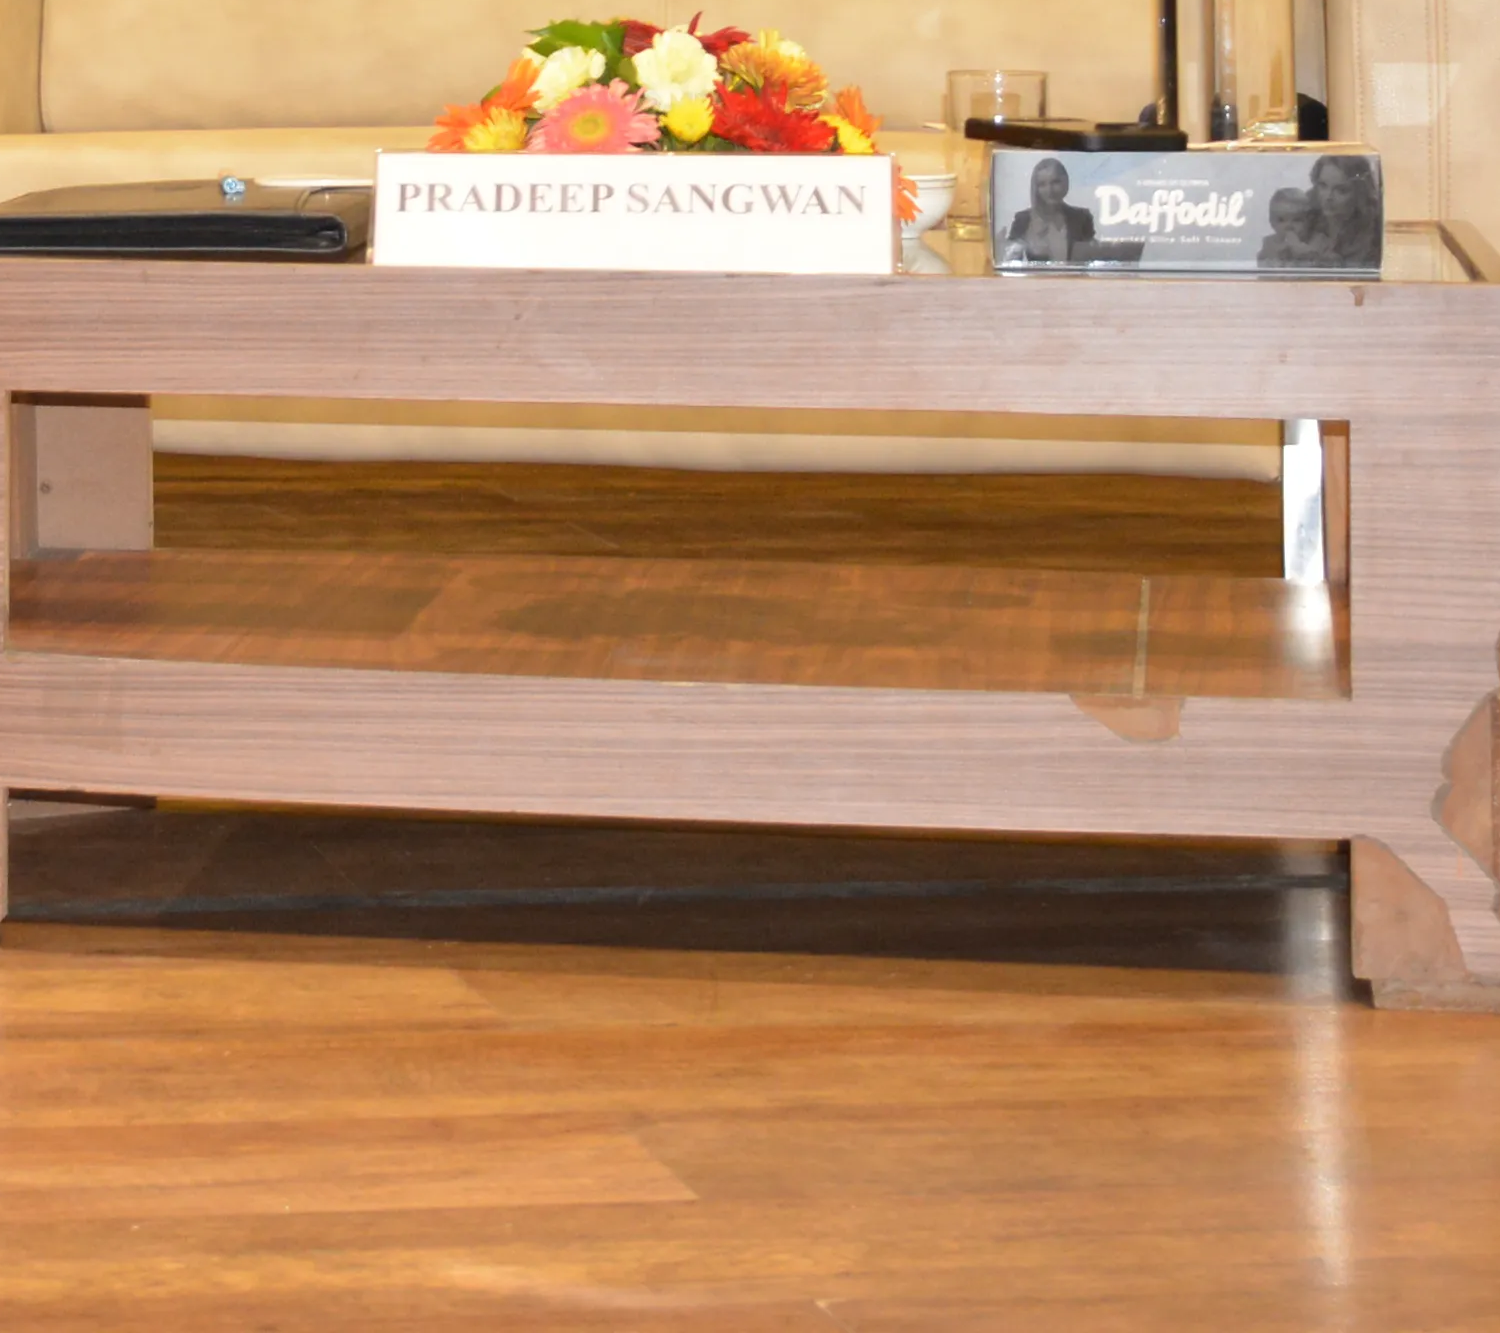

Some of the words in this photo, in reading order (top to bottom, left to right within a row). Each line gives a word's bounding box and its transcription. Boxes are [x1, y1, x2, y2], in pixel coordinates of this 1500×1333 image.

[395, 182, 615, 214] PRADEEP
[625, 182, 867, 216] SANGWAN
[1094, 184, 1246, 234] Daffodil
